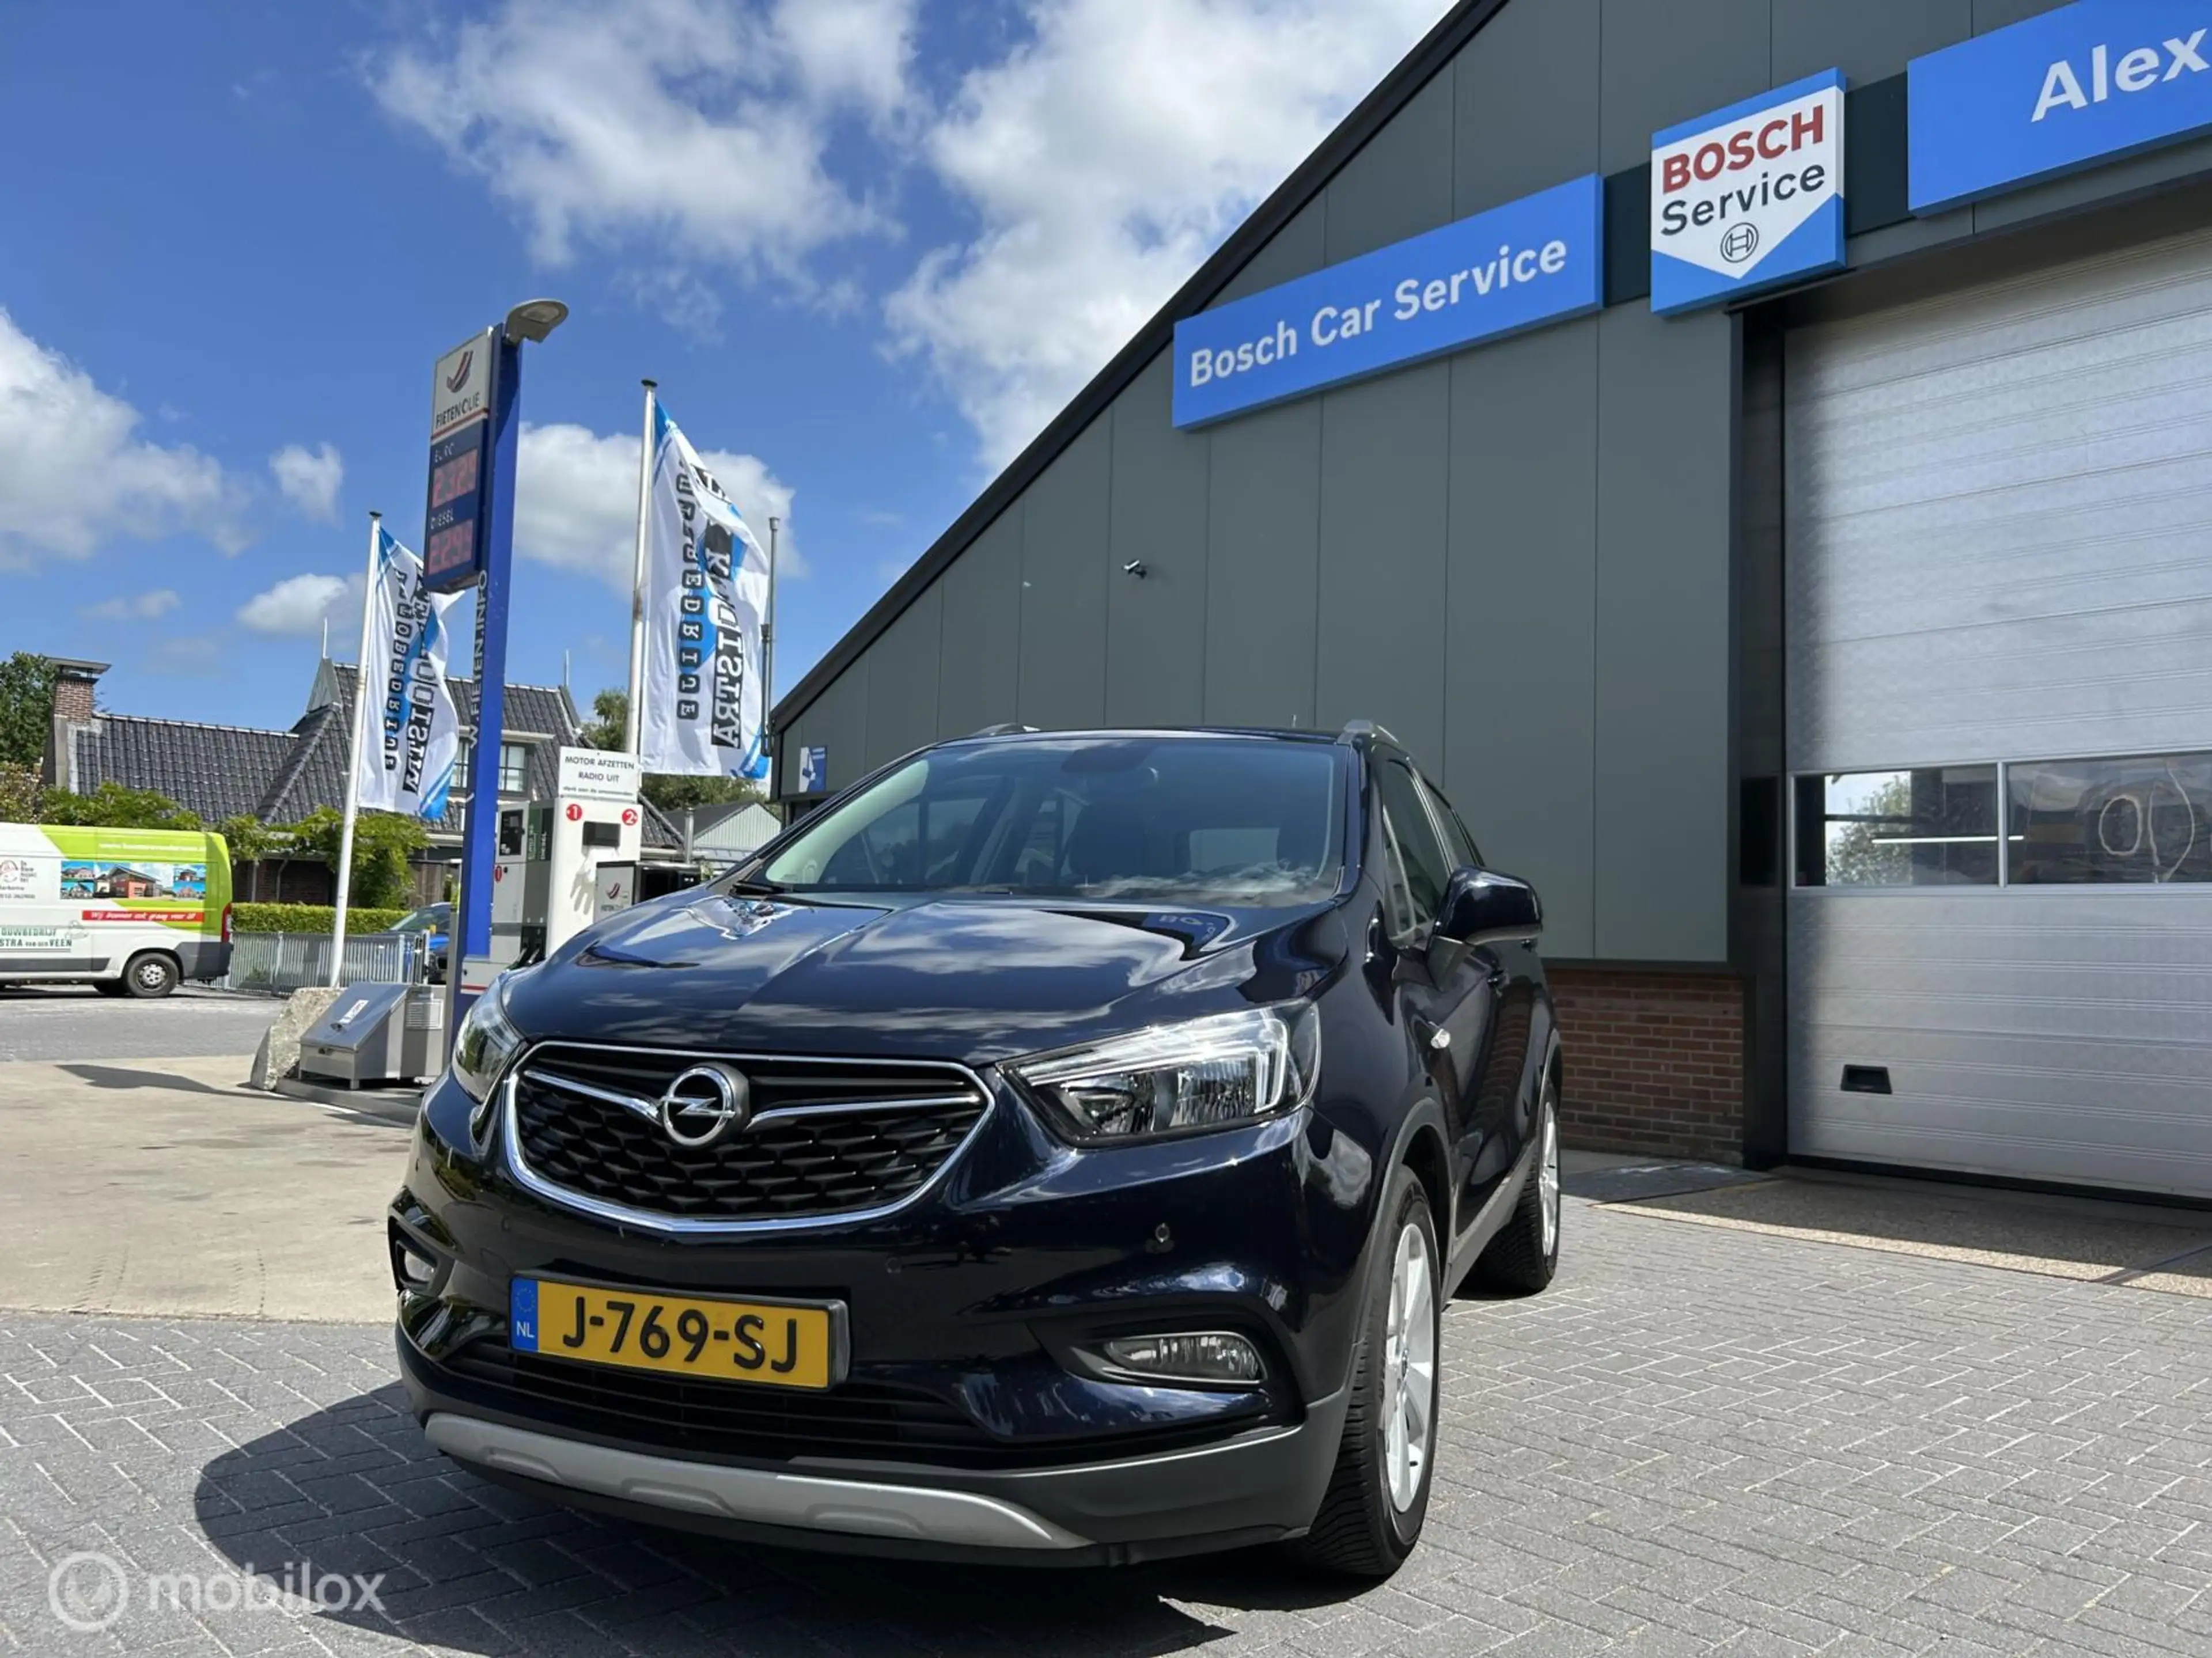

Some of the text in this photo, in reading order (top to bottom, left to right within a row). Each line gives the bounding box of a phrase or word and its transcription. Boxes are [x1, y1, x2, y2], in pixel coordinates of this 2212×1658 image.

[2031, 28, 2210, 122] Alex
[1662, 104, 1823, 195] BOSCH
[1661, 164, 1825, 236] Service
[1190, 240, 1566, 387] Bosch Car Service
[565, 756, 634, 769] MOTOR AFZETTEN
[578, 771, 619, 782] RADIO UIT
[516, 1321, 535, 1339] NL
[562, 1296, 797, 1373] J-769-SJ
